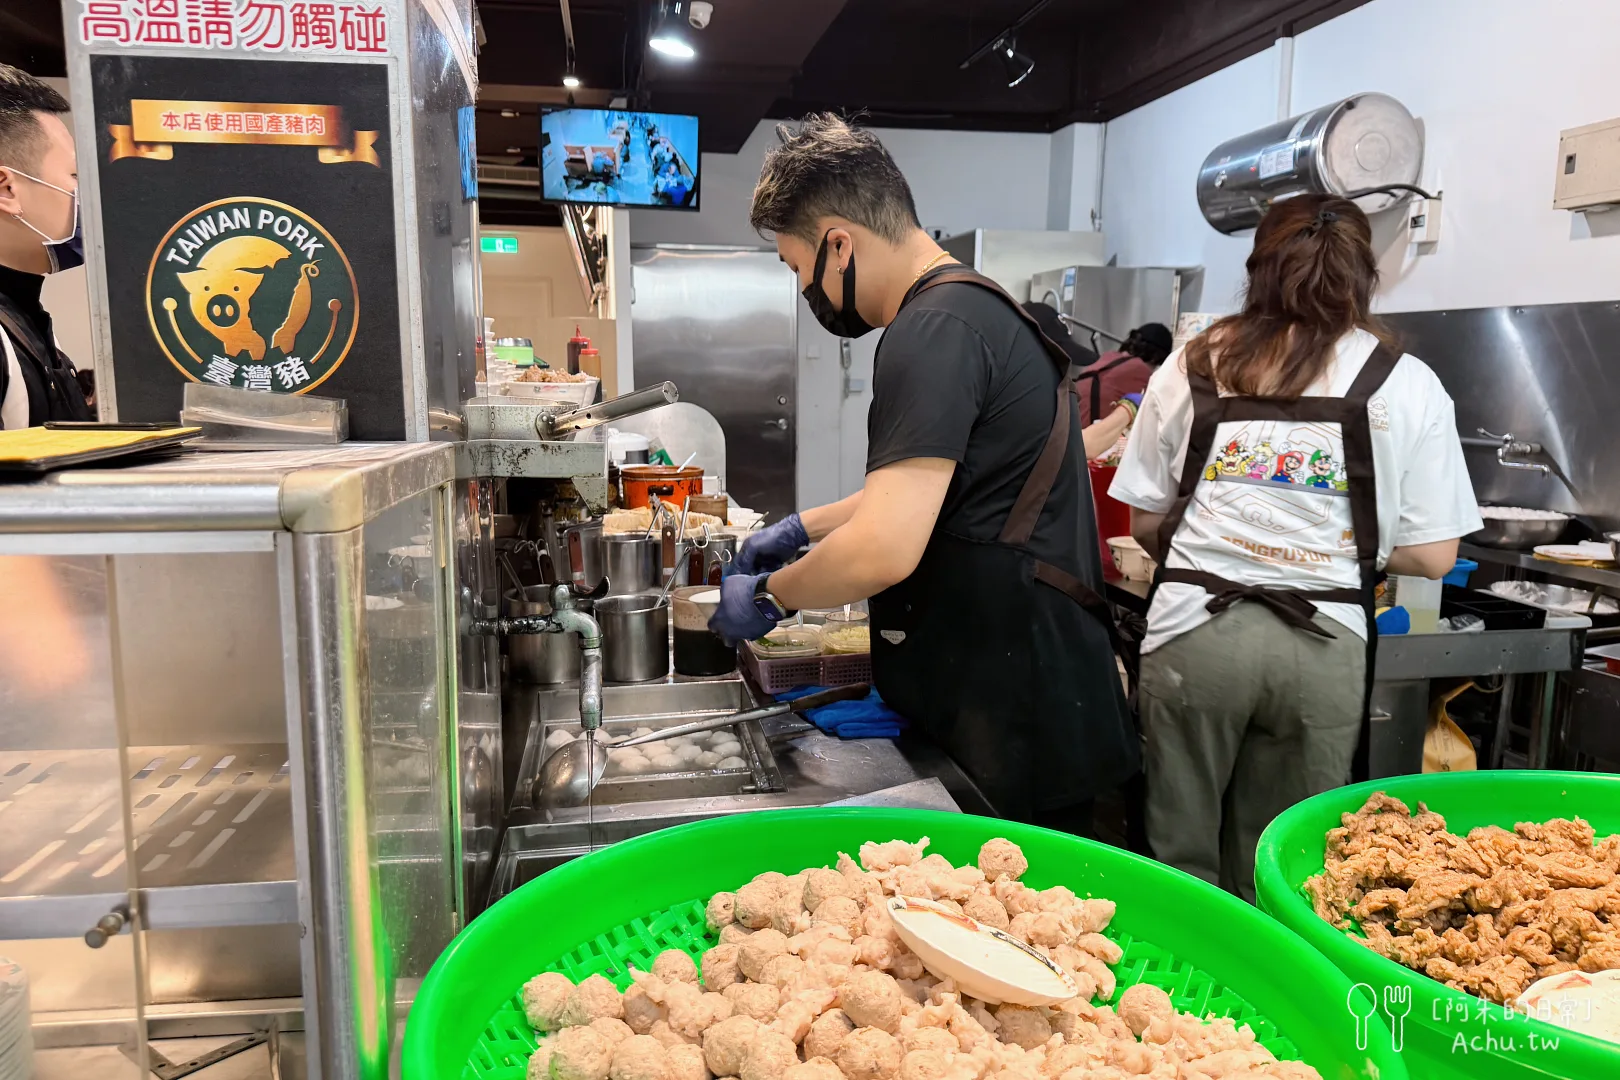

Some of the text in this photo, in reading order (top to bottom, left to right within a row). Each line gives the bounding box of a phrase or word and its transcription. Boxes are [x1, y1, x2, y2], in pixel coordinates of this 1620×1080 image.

[82, 0, 388, 53] 高溫請勿觸碰
[161, 111, 326, 135] 本店使用國產豬肉
[166, 207, 326, 267] TAIWAN PORK
[203, 354, 311, 392] 臺灣豬
